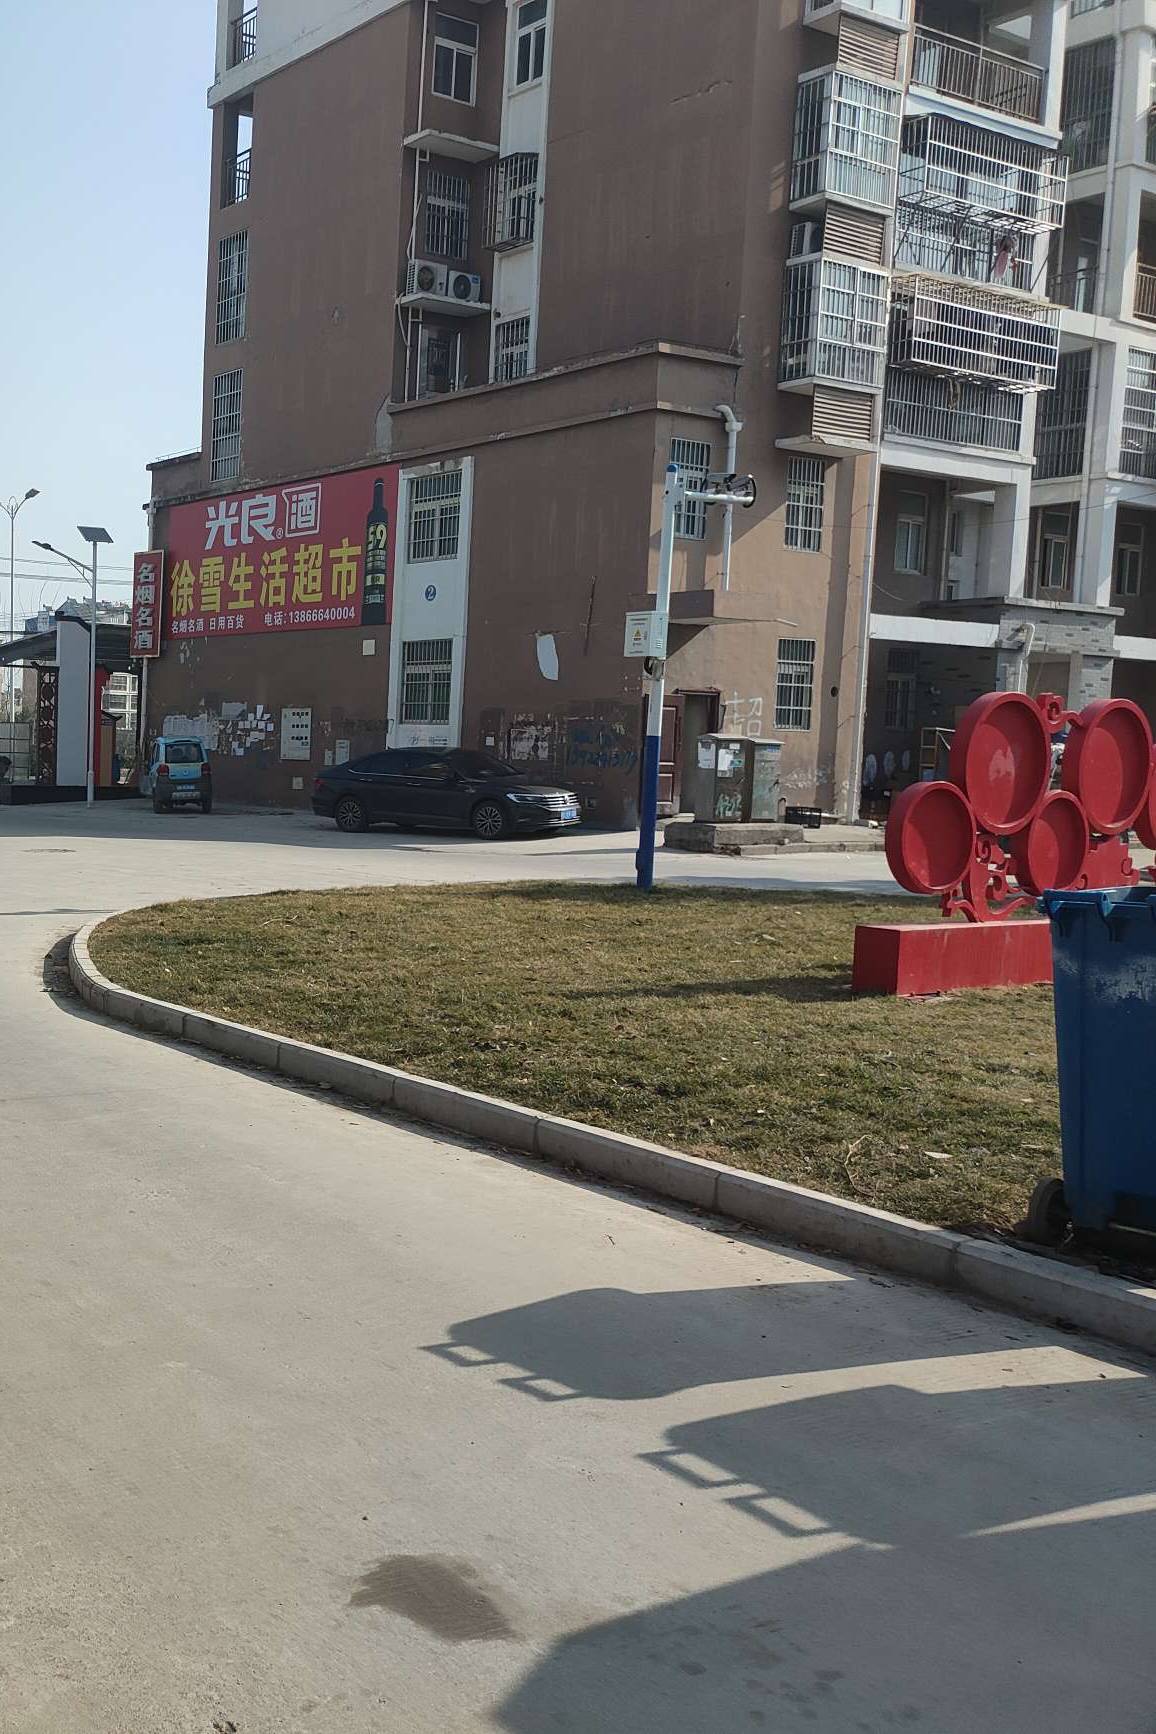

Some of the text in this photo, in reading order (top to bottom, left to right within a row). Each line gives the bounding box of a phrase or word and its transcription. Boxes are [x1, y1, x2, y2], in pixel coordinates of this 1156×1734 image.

[134, 563, 155, 650] 名烟名酒
[171, 537, 362, 617] 徐雪生活超市
[172, 614, 244, 634] 名烟名酒 日用百货
